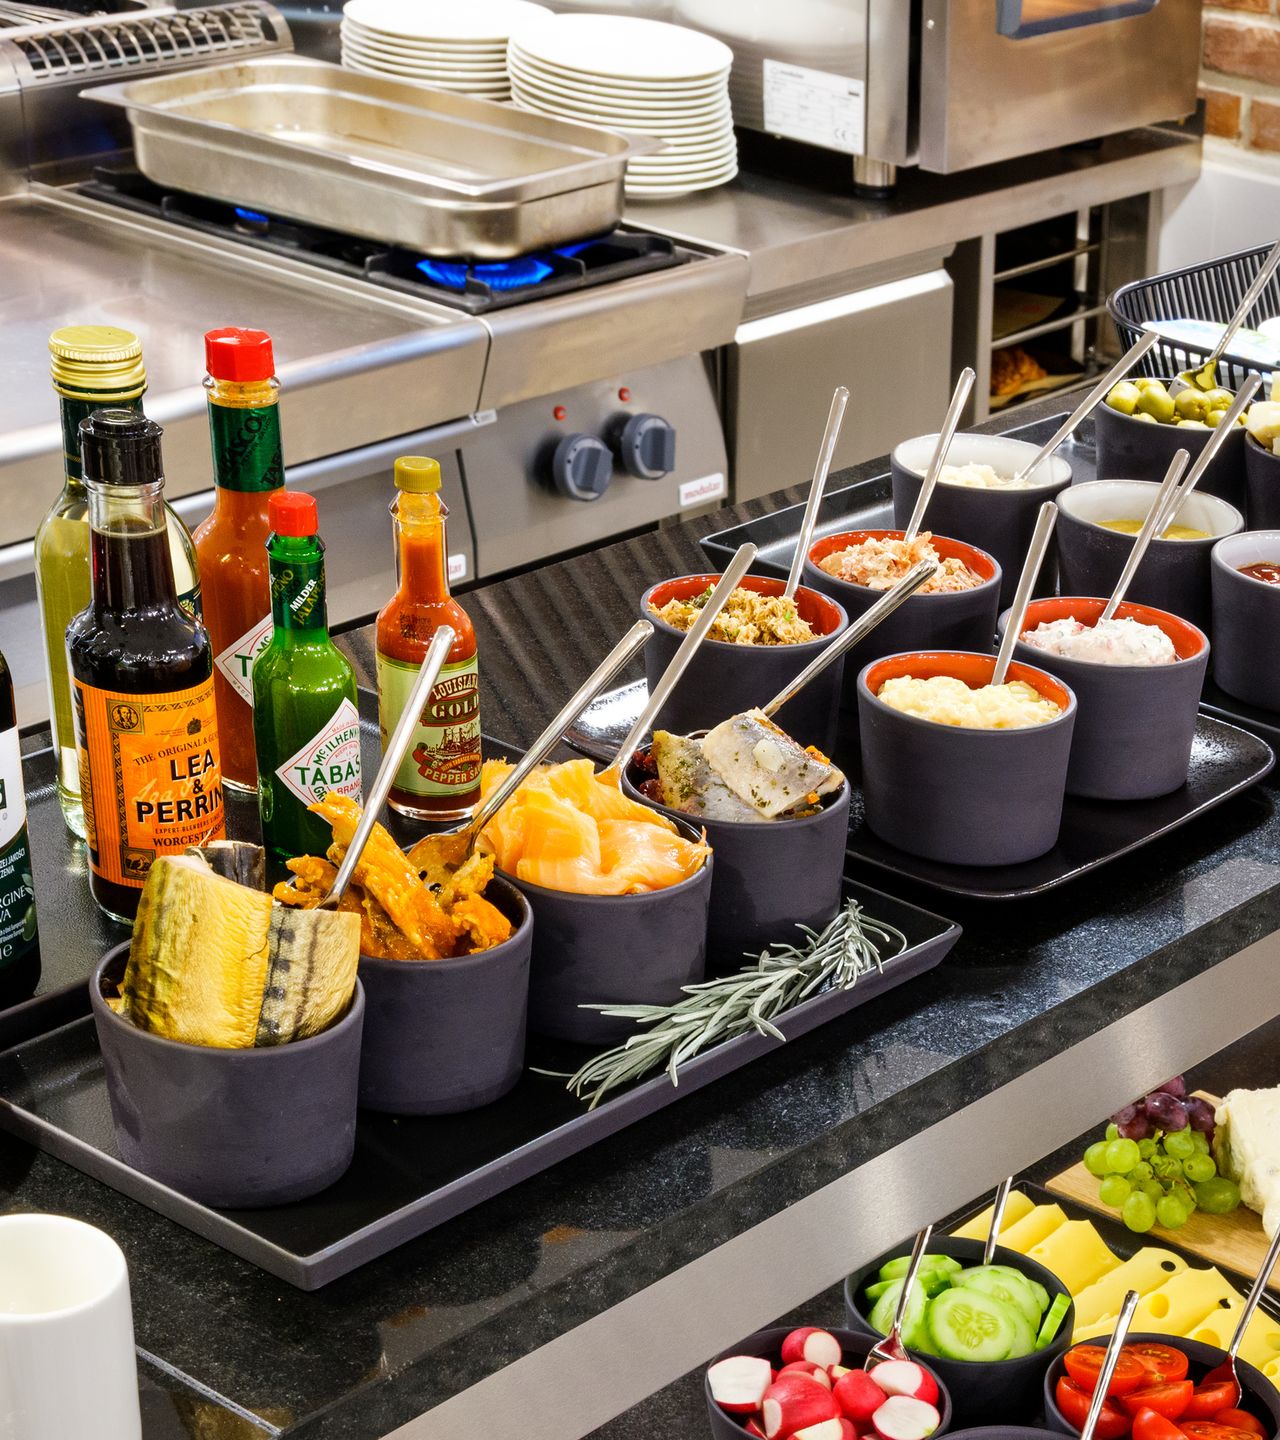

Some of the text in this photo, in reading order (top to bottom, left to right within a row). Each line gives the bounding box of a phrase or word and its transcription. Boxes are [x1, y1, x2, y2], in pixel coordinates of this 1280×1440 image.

[290, 578, 318, 613] MILDER
[133, 753, 156, 766] THE
[158, 739, 201, 758] ORIGINAL
[170, 748, 216, 781] LEA
[192, 778, 204, 795] &
[424, 768, 467, 784] PEPPER
